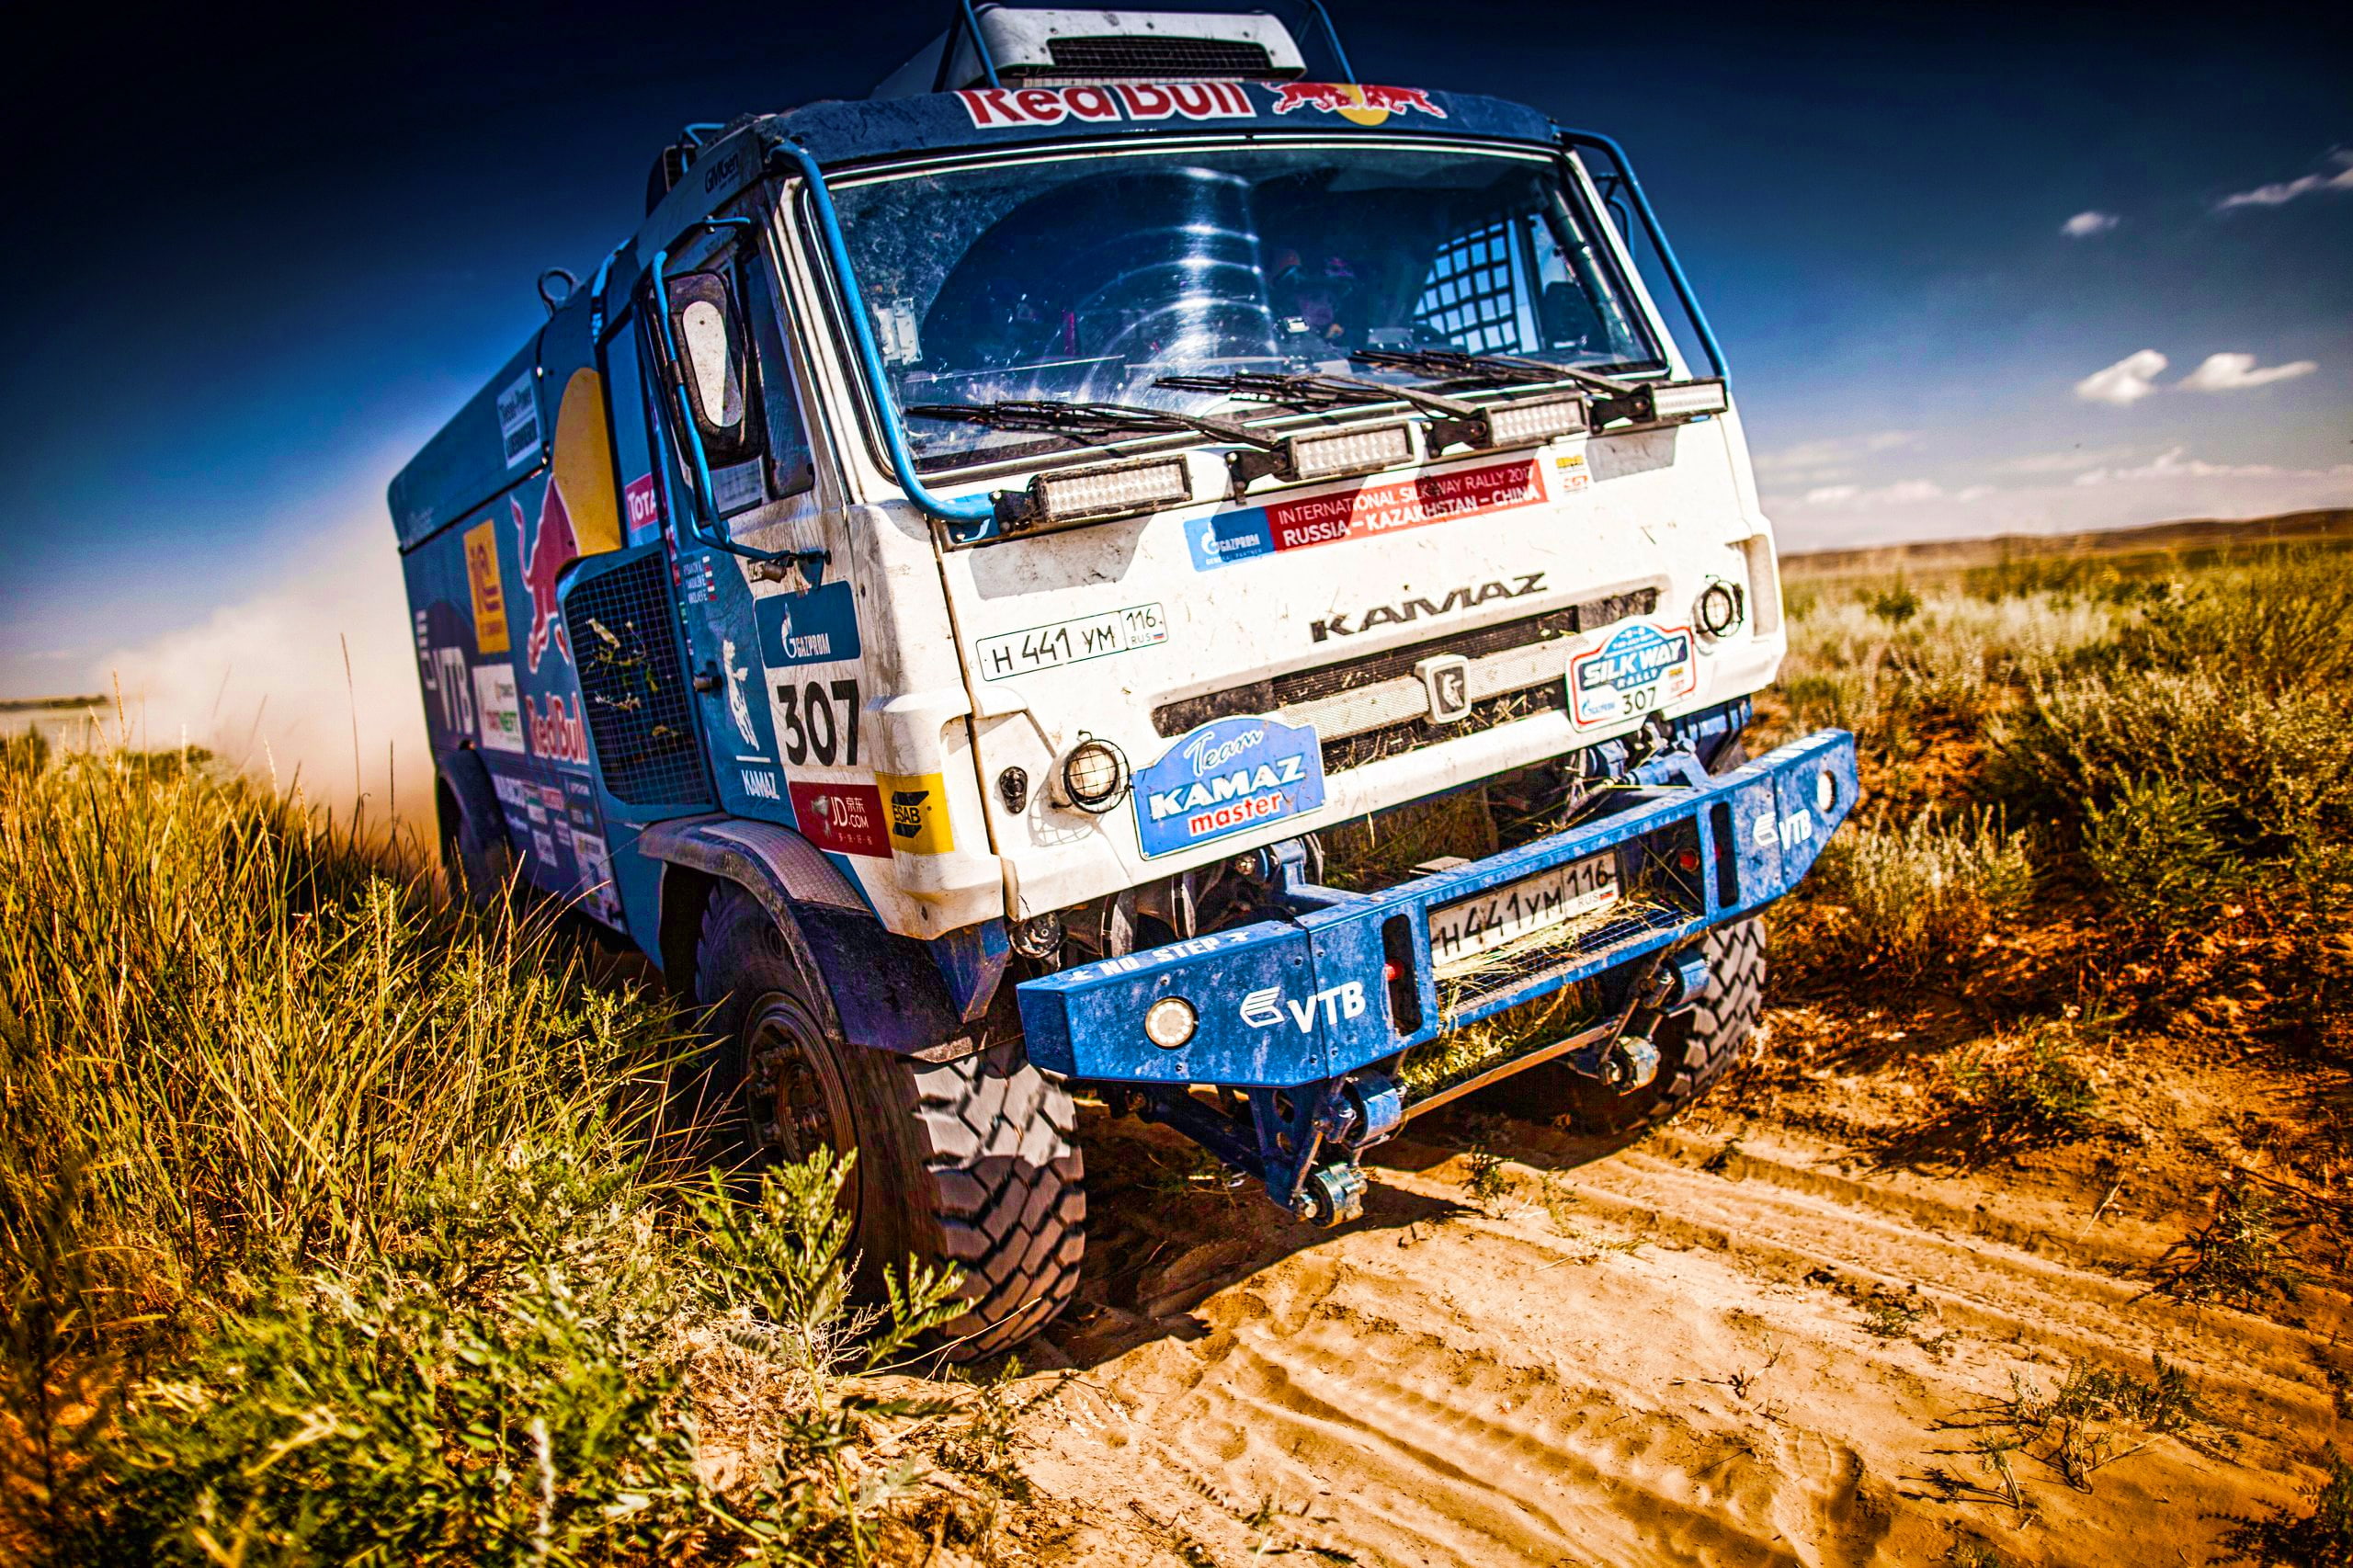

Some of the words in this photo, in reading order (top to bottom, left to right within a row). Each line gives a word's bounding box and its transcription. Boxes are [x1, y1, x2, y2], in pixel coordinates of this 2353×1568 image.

[960, 85, 1120, 127] Red
[1125, 83, 1256, 119] Bull
[1278, 491, 1398, 525] INTERNATIONAL
[1399, 485, 1431, 503] SILK
[1432, 480, 1462, 496] WAY
[1464, 472, 1505, 490] RALLY
[1507, 465, 1533, 483] 2017
[1282, 519, 1351, 547] RUSSIA
[1365, 495, 1479, 531] KAZAKHSTAN
[1492, 484, 1541, 506] CHINA
[1220, 533, 1260, 551] GAZPROM
[1310, 572, 1548, 642] KAMAZ
[795, 632, 831, 657] GAZPROM
[1022, 628, 1073, 665] 441
[1126, 608, 1157, 632] 116
[1131, 632, 1152, 644] RUS
[1583, 652, 1637, 687] SILK
[1639, 638, 1684, 670] WAY
[1622, 686, 1656, 714] 307
[525, 691, 558, 759] Red
[551, 691, 589, 765] Bull
[777, 677, 858, 767] 307
[1184, 730, 1264, 776] Team
[741, 769, 780, 800] KAMAZ
[846, 797, 865, 812] 京东
[1149, 755, 1305, 821] KAMAZ
[831, 796, 847, 826] JD
[892, 805, 921, 824] ESAB
[1189, 793, 1283, 835] master
[1779, 809, 1812, 850] VTB
[1567, 859, 1608, 897] 116
[1578, 892, 1599, 907] RUS
[1098, 956, 1139, 977] NO
[1153, 936, 1221, 964] STEP
[1288, 981, 1366, 1034] VTB
